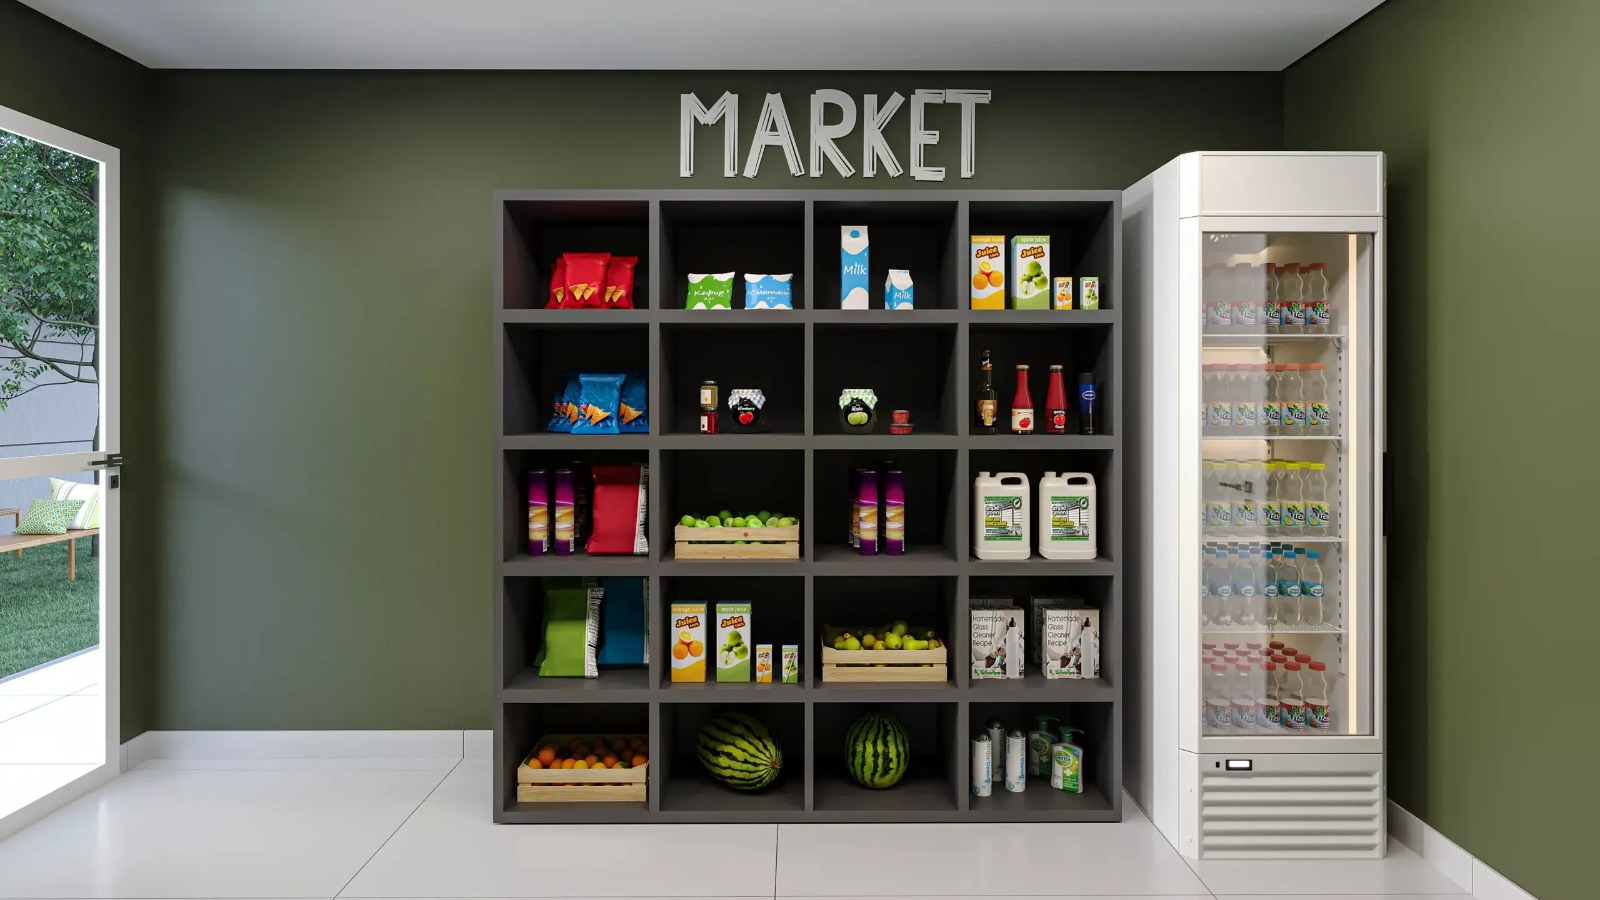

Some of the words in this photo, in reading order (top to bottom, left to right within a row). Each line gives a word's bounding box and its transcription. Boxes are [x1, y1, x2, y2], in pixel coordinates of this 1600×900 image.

[680, 88, 992, 181] MARKET
[976, 246, 998, 258] Juice
[1021, 246, 1043, 258] Juice
[843, 262, 867, 275] Milk
[894, 290, 912, 300] Milk
[676, 616, 698, 628] Juice
[721, 616, 743, 628] Juice
